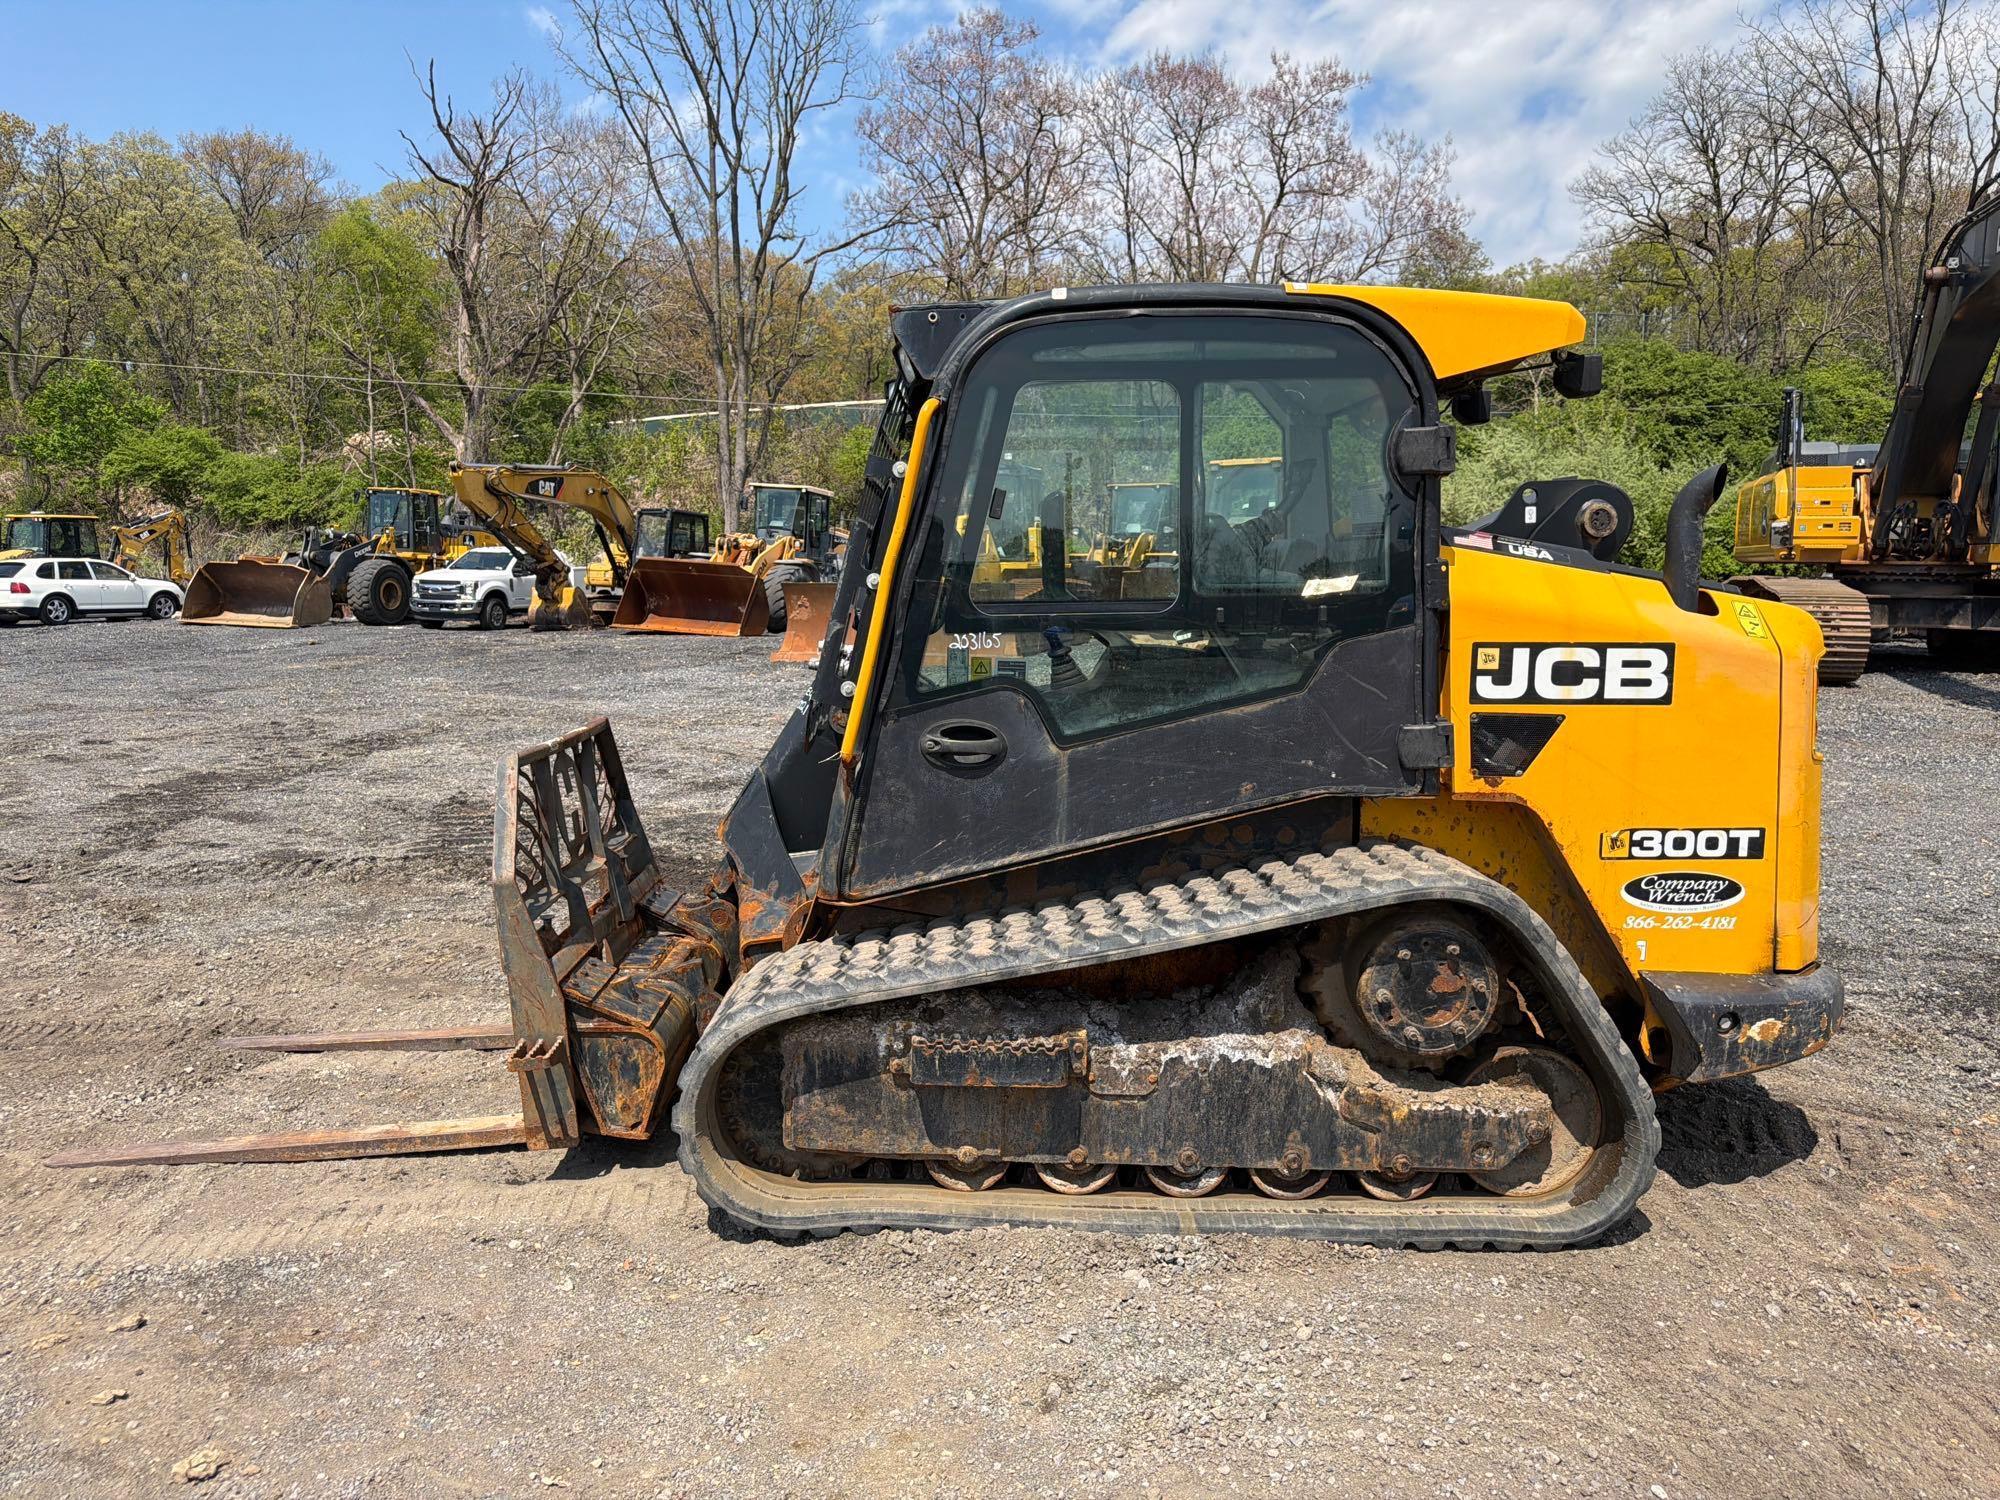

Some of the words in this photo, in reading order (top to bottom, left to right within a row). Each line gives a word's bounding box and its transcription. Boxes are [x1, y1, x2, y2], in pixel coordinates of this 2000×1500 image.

[539, 480, 555, 497] CAT
[353, 545, 372, 558] DEERE
[1508, 544, 1554, 561] USA
[949, 631, 1002, 650] 203165
[1481, 652, 1497, 665] JCB
[1475, 647, 1669, 699] JCB
[1606, 836, 1626, 852] JCB
[1631, 830, 1760, 857] 300T
[1641, 876, 1729, 893] Company
[1648, 888, 1715, 903] Wrench
